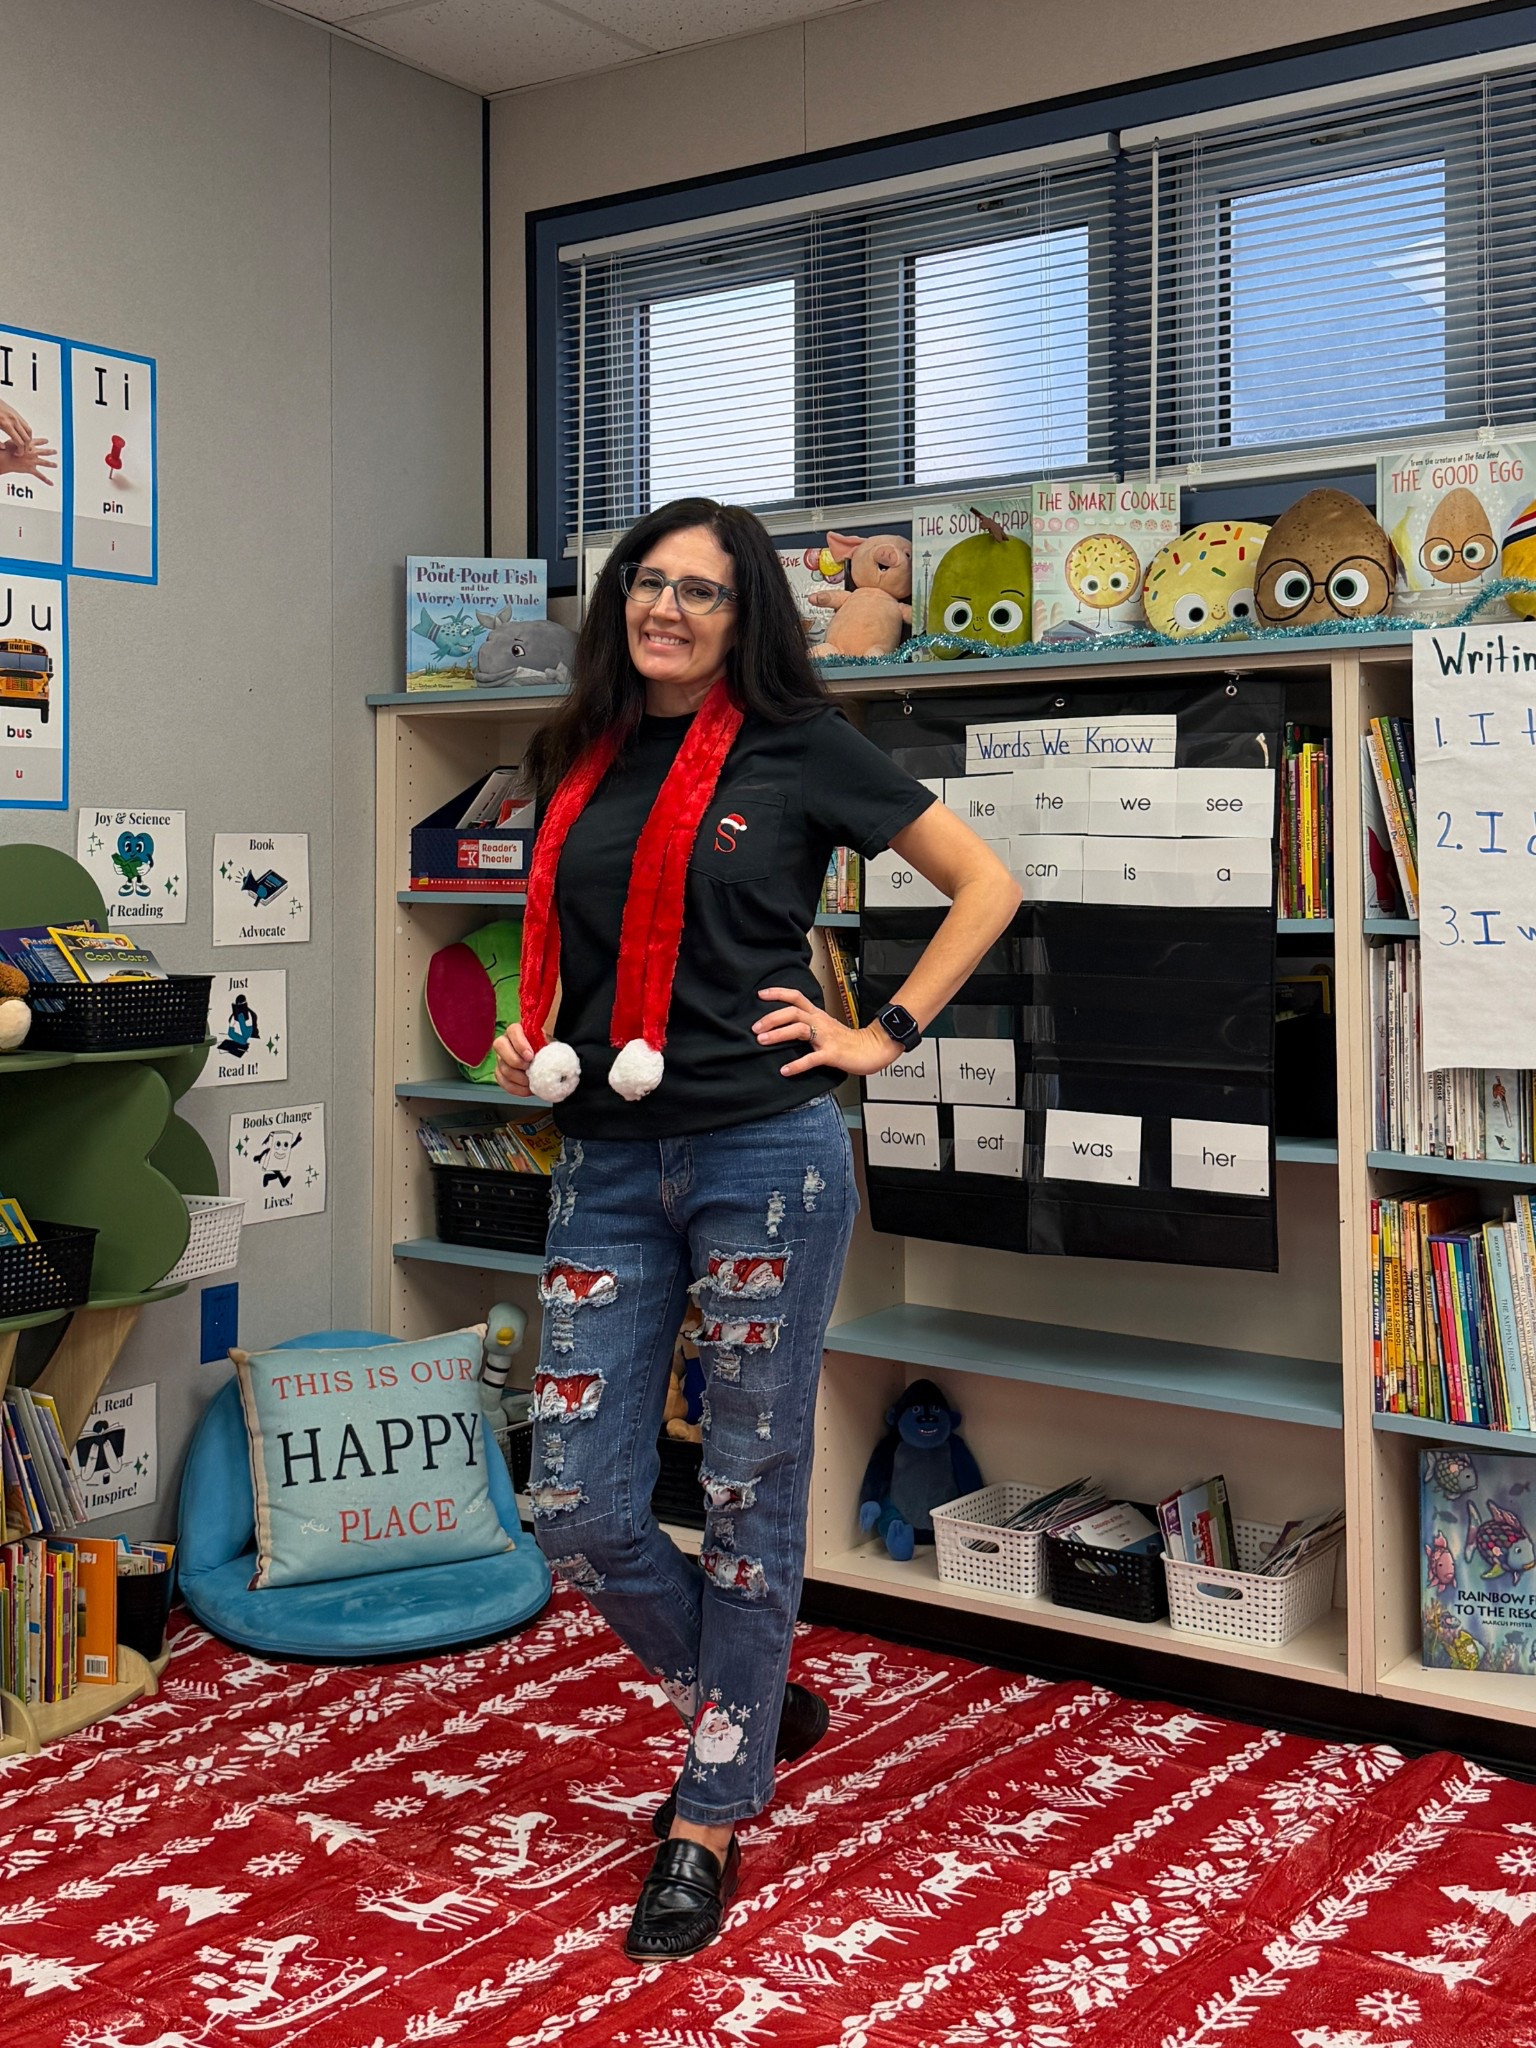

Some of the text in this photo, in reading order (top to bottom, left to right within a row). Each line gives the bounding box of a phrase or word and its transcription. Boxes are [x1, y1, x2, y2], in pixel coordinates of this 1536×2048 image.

[94, 366, 129, 410] I i
[1392, 460, 1524, 494] THE GOOD EGG
[7, 483, 33, 499] itch
[1038, 491, 1176, 511] THE SMART COOKIE
[103, 500, 123, 514] pin
[919, 517, 943, 537] THE
[415, 566, 538, 586] Pout-Pout Fish
[430, 562, 445, 570] The
[416, 592, 540, 607] Worry-Worry Whale
[31, 604, 51, 631] u
[7, 725, 33, 739] bus
[1468, 712, 1500, 746] I
[976, 726, 1154, 760] Words We Know
[16, 769, 23, 778] u
[968, 792, 1243, 818] like the we see
[94, 812, 171, 827] Joy & Science
[1475, 811, 1507, 853] I
[249, 838, 275, 851] Book
[467, 852, 478, 866] K
[890, 862, 1231, 889] go can is a
[117, 904, 164, 919] Reading
[238, 925, 286, 939] Advocate
[1469, 910, 1506, 945] I
[85, 951, 149, 962] Cool Cars
[228, 976, 249, 991] Just
[218, 1062, 259, 1079] Read It!
[959, 1063, 996, 1085] they
[242, 1109, 313, 1130] Books Change
[881, 1128, 1237, 1168] down eat was her
[263, 1193, 294, 1210] Lives!
[1503, 1315, 1513, 1346] NAPPING
[1507, 1348, 1516, 1372] HOUSE
[272, 1358, 474, 1400] THIS IS OUR
[105, 1393, 133, 1412] Read
[277, 1412, 479, 1488] HAPPY
[91, 1483, 138, 1508] Inspire!
[339, 1498, 458, 1543] PLACE
[1458, 1590, 1526, 1605] RAINBOW
[1455, 1602, 1475, 1616] TO
[1477, 1605, 1505, 1618] THE
